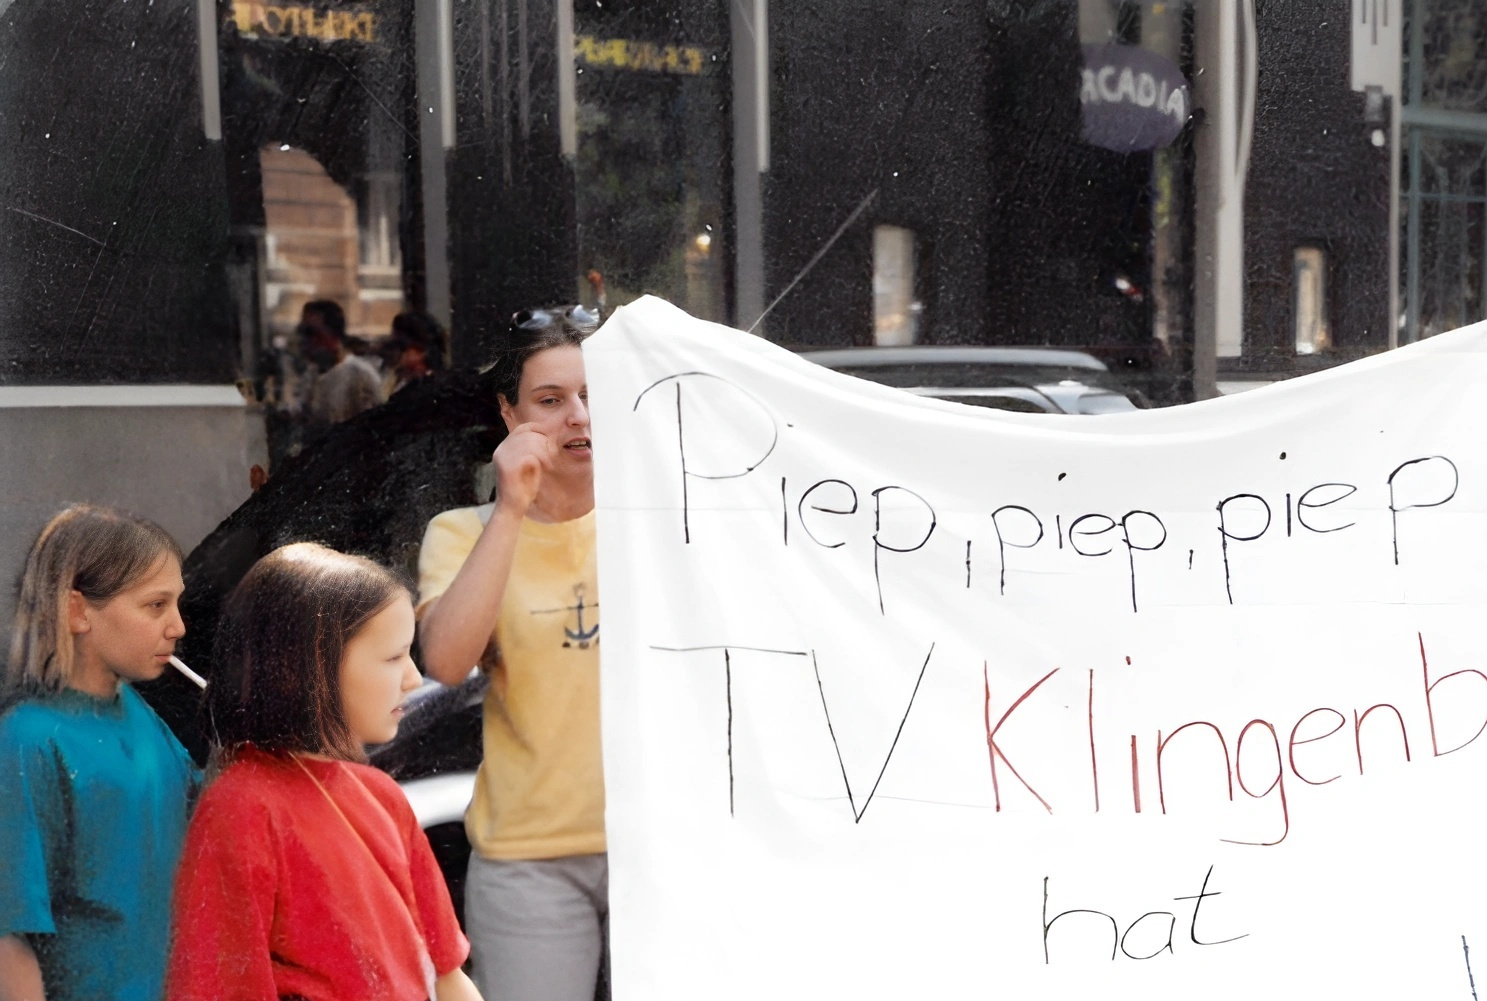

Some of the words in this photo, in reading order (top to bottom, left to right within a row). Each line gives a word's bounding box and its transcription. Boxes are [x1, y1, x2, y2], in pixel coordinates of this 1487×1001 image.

[633, 370, 972, 617] Piep,
[991, 470, 1195, 613] piep,
[648, 641, 937, 824] TV
[1041, 864, 1251, 966] hat
